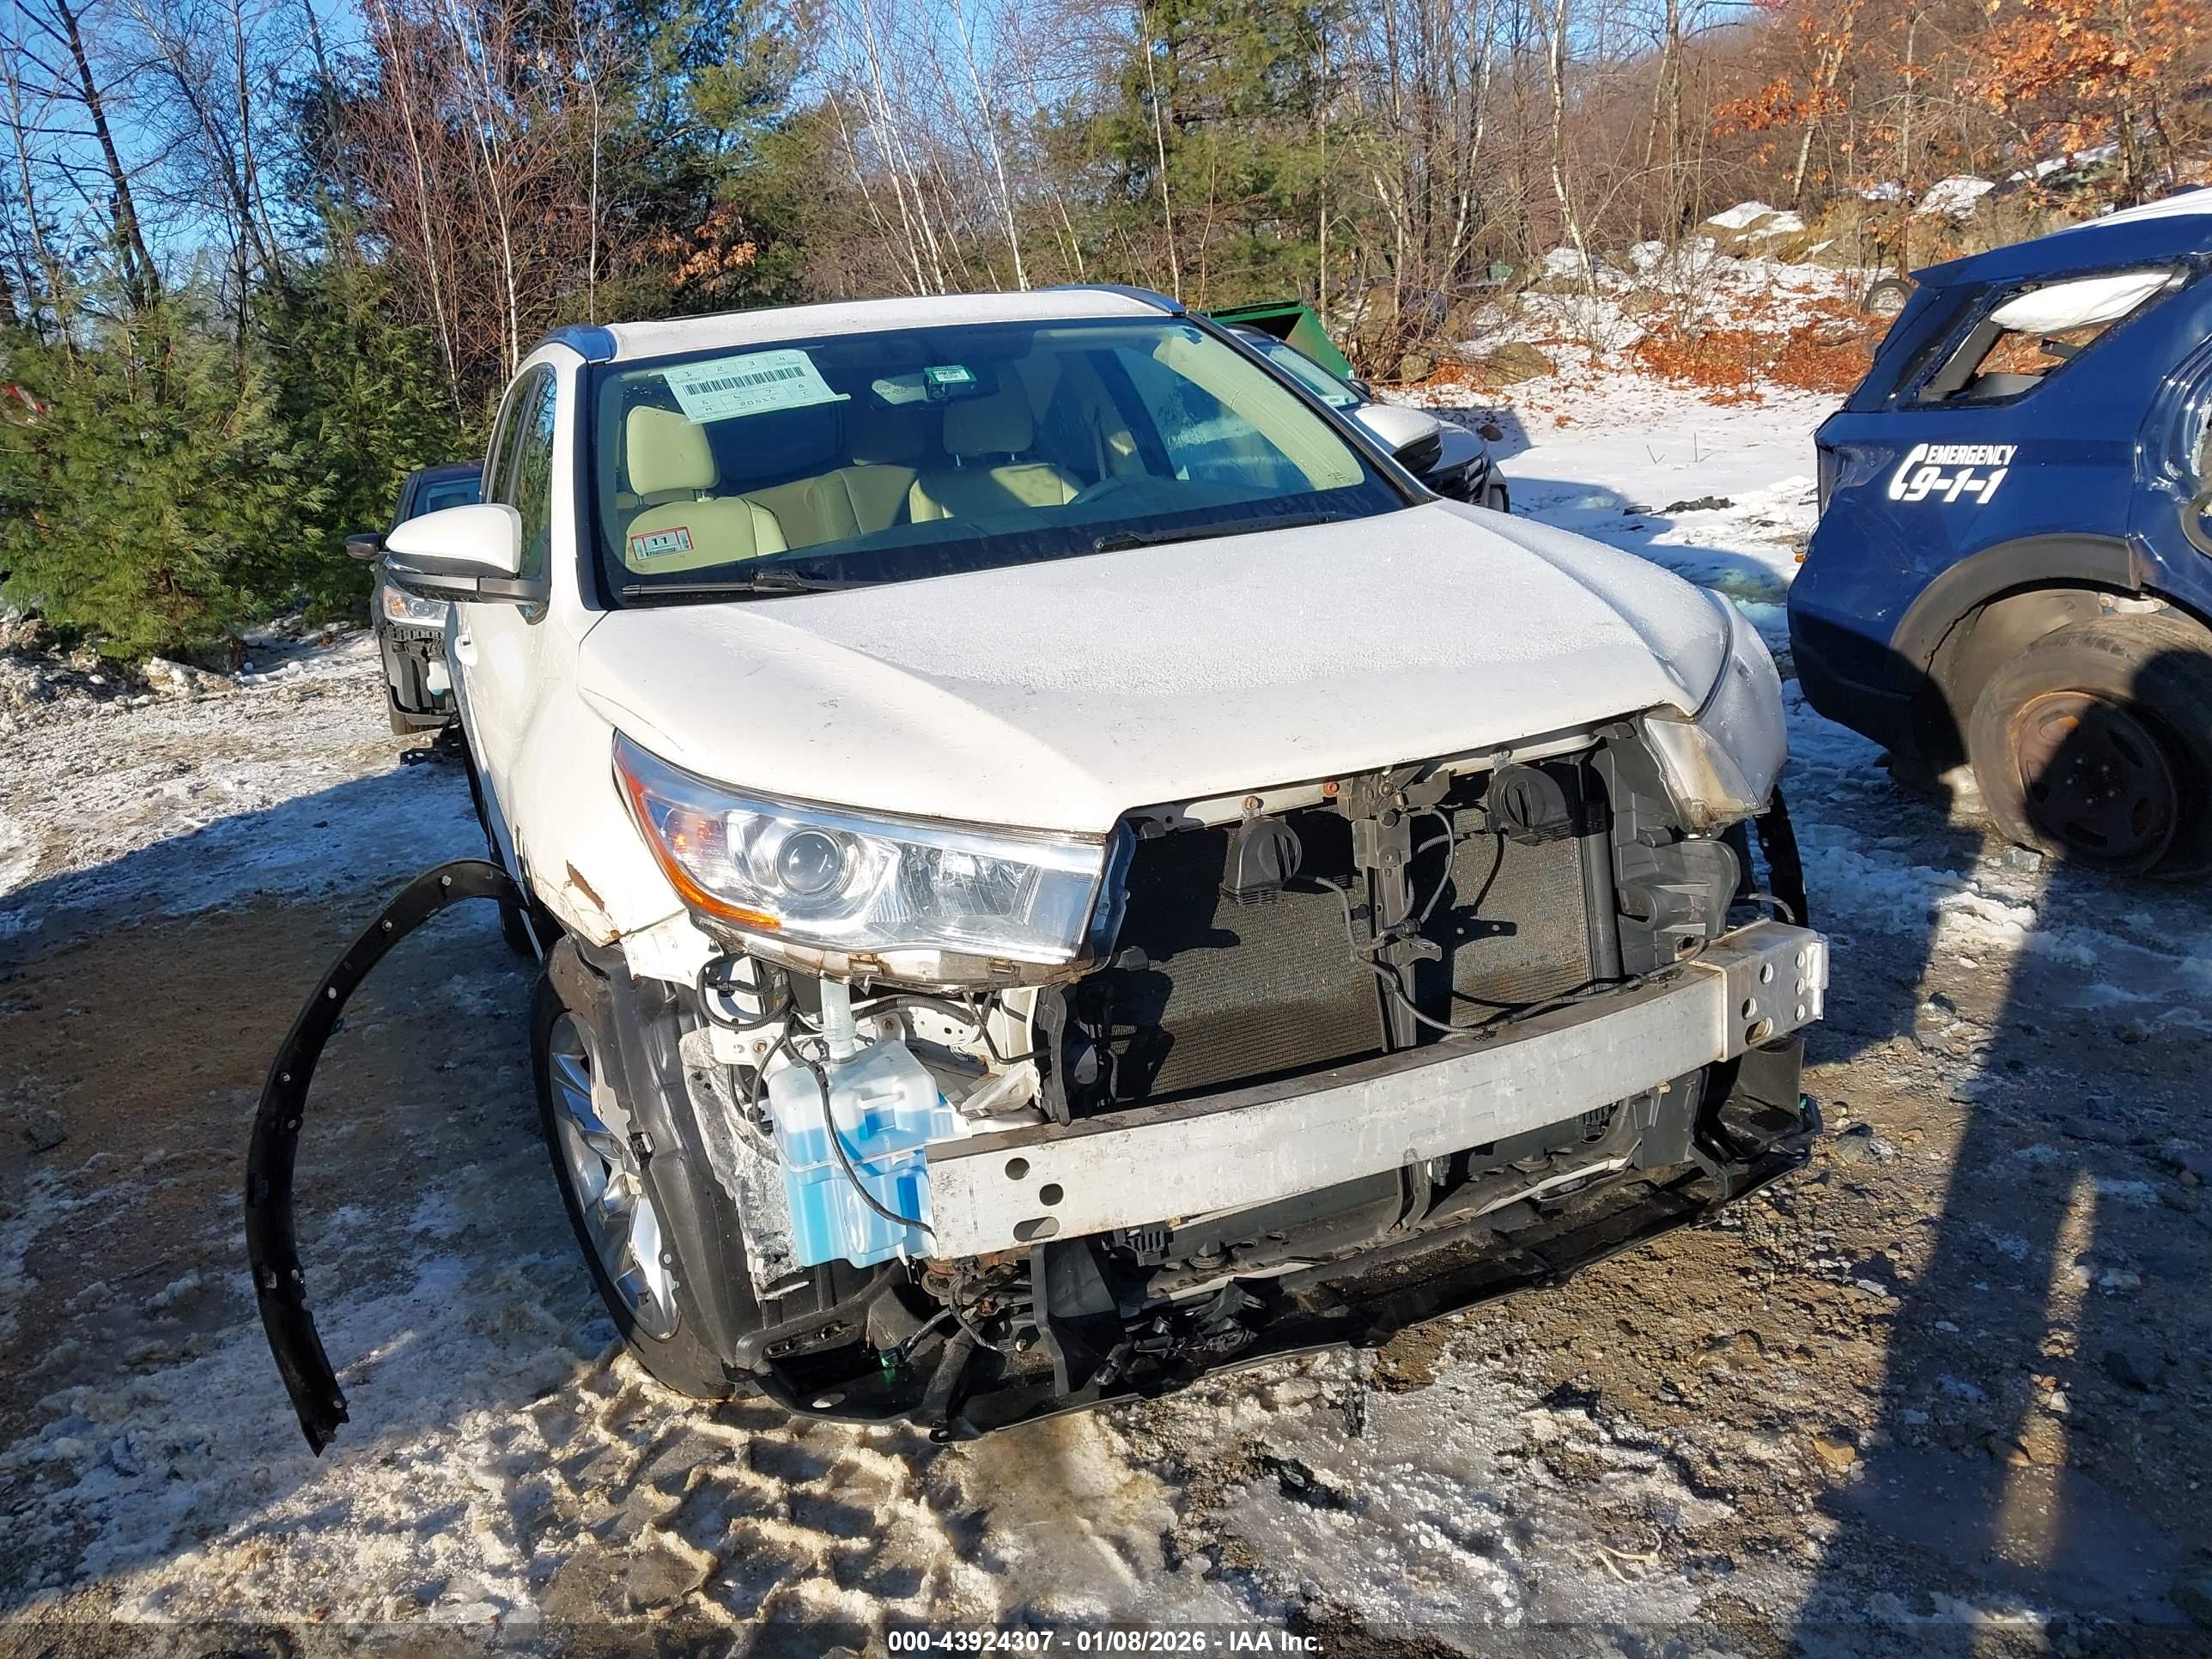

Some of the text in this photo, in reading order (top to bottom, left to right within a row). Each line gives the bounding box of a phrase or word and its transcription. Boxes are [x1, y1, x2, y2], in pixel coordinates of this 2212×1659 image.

[1924, 445, 2018, 465] EMERGENCY
[1900, 466, 2008, 504] 9-1-1
[651, 536, 668, 546] 11
